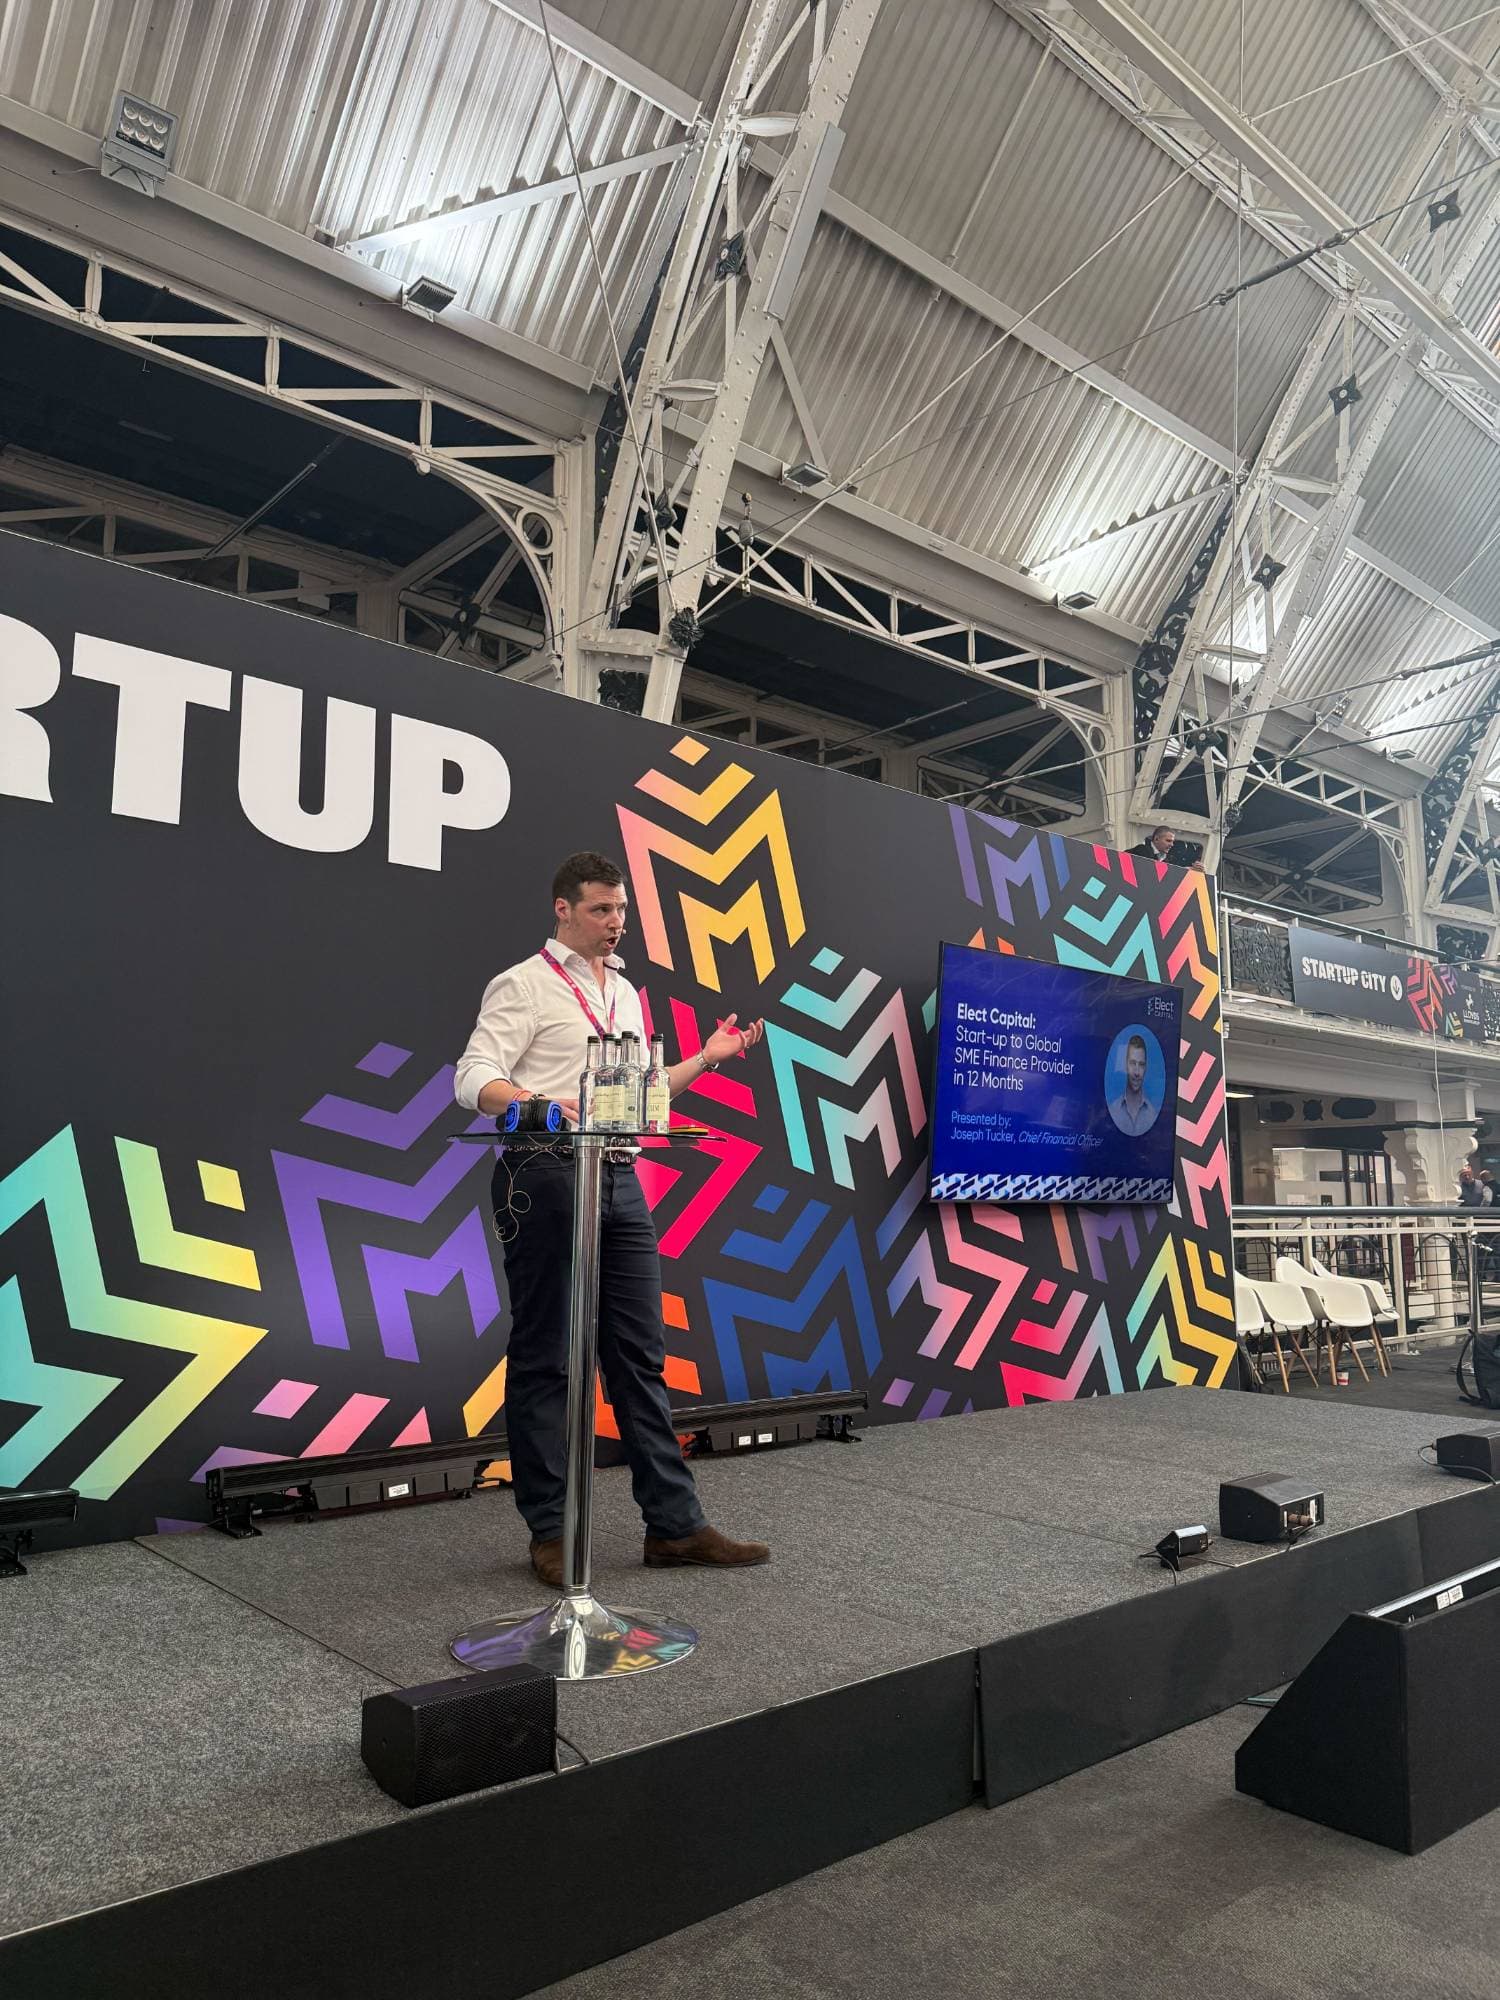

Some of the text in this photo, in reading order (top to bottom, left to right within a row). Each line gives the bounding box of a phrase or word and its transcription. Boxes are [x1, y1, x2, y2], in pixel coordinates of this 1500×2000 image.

[1302, 956, 1387, 993] STARTUP CITY
[1154, 996, 1174, 1012] Elect
[957, 1003, 1036, 1030] Elect Capital:
[956, 1025, 1062, 1054] Start-up to Global
[955, 1047, 1075, 1075] SME Finance Provider
[953, 1069, 1024, 1091] in 12 Months
[951, 1110, 1012, 1129] Presented by:
[950, 1127, 1105, 1147] Joseph Tucker, Chief Financial Officer
